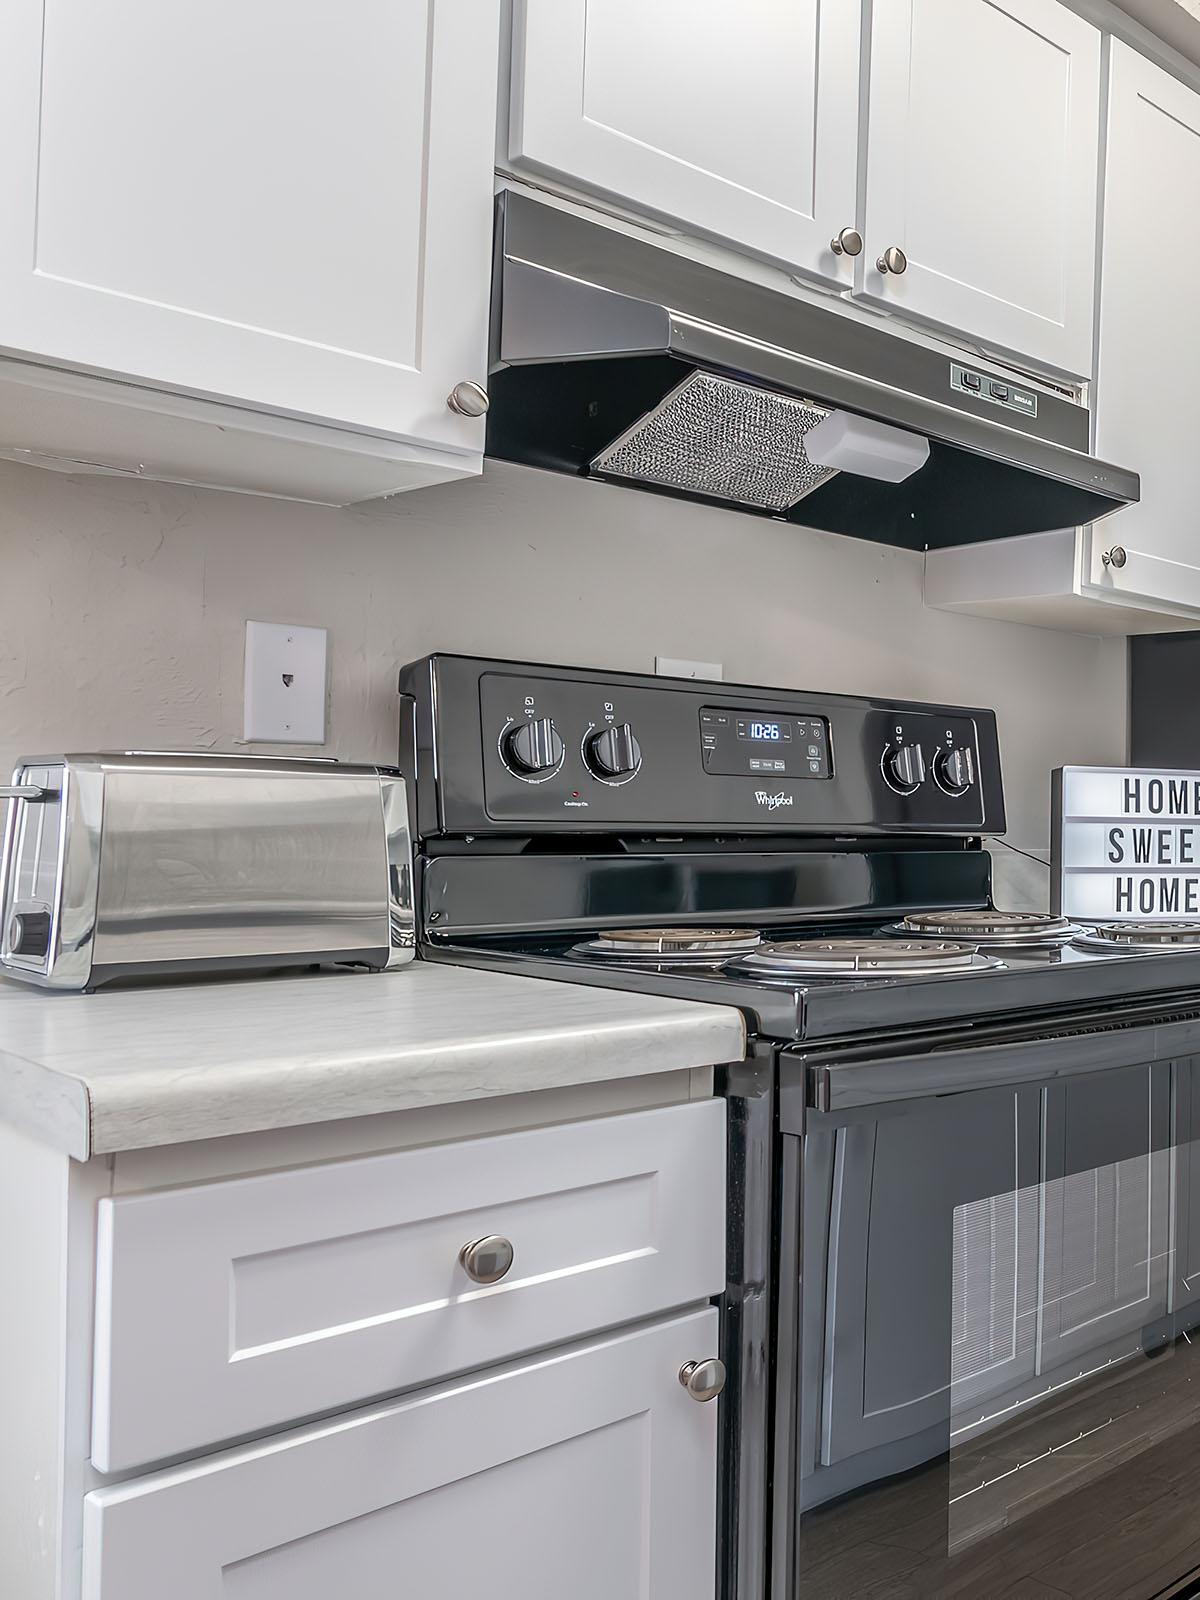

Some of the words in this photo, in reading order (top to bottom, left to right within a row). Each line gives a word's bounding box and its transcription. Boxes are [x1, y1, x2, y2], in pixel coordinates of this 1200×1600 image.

[751, 723, 779, 739] 10:26
[754, 791, 793, 810] Whirlpool
[1116, 877, 1199, 913] HOME
